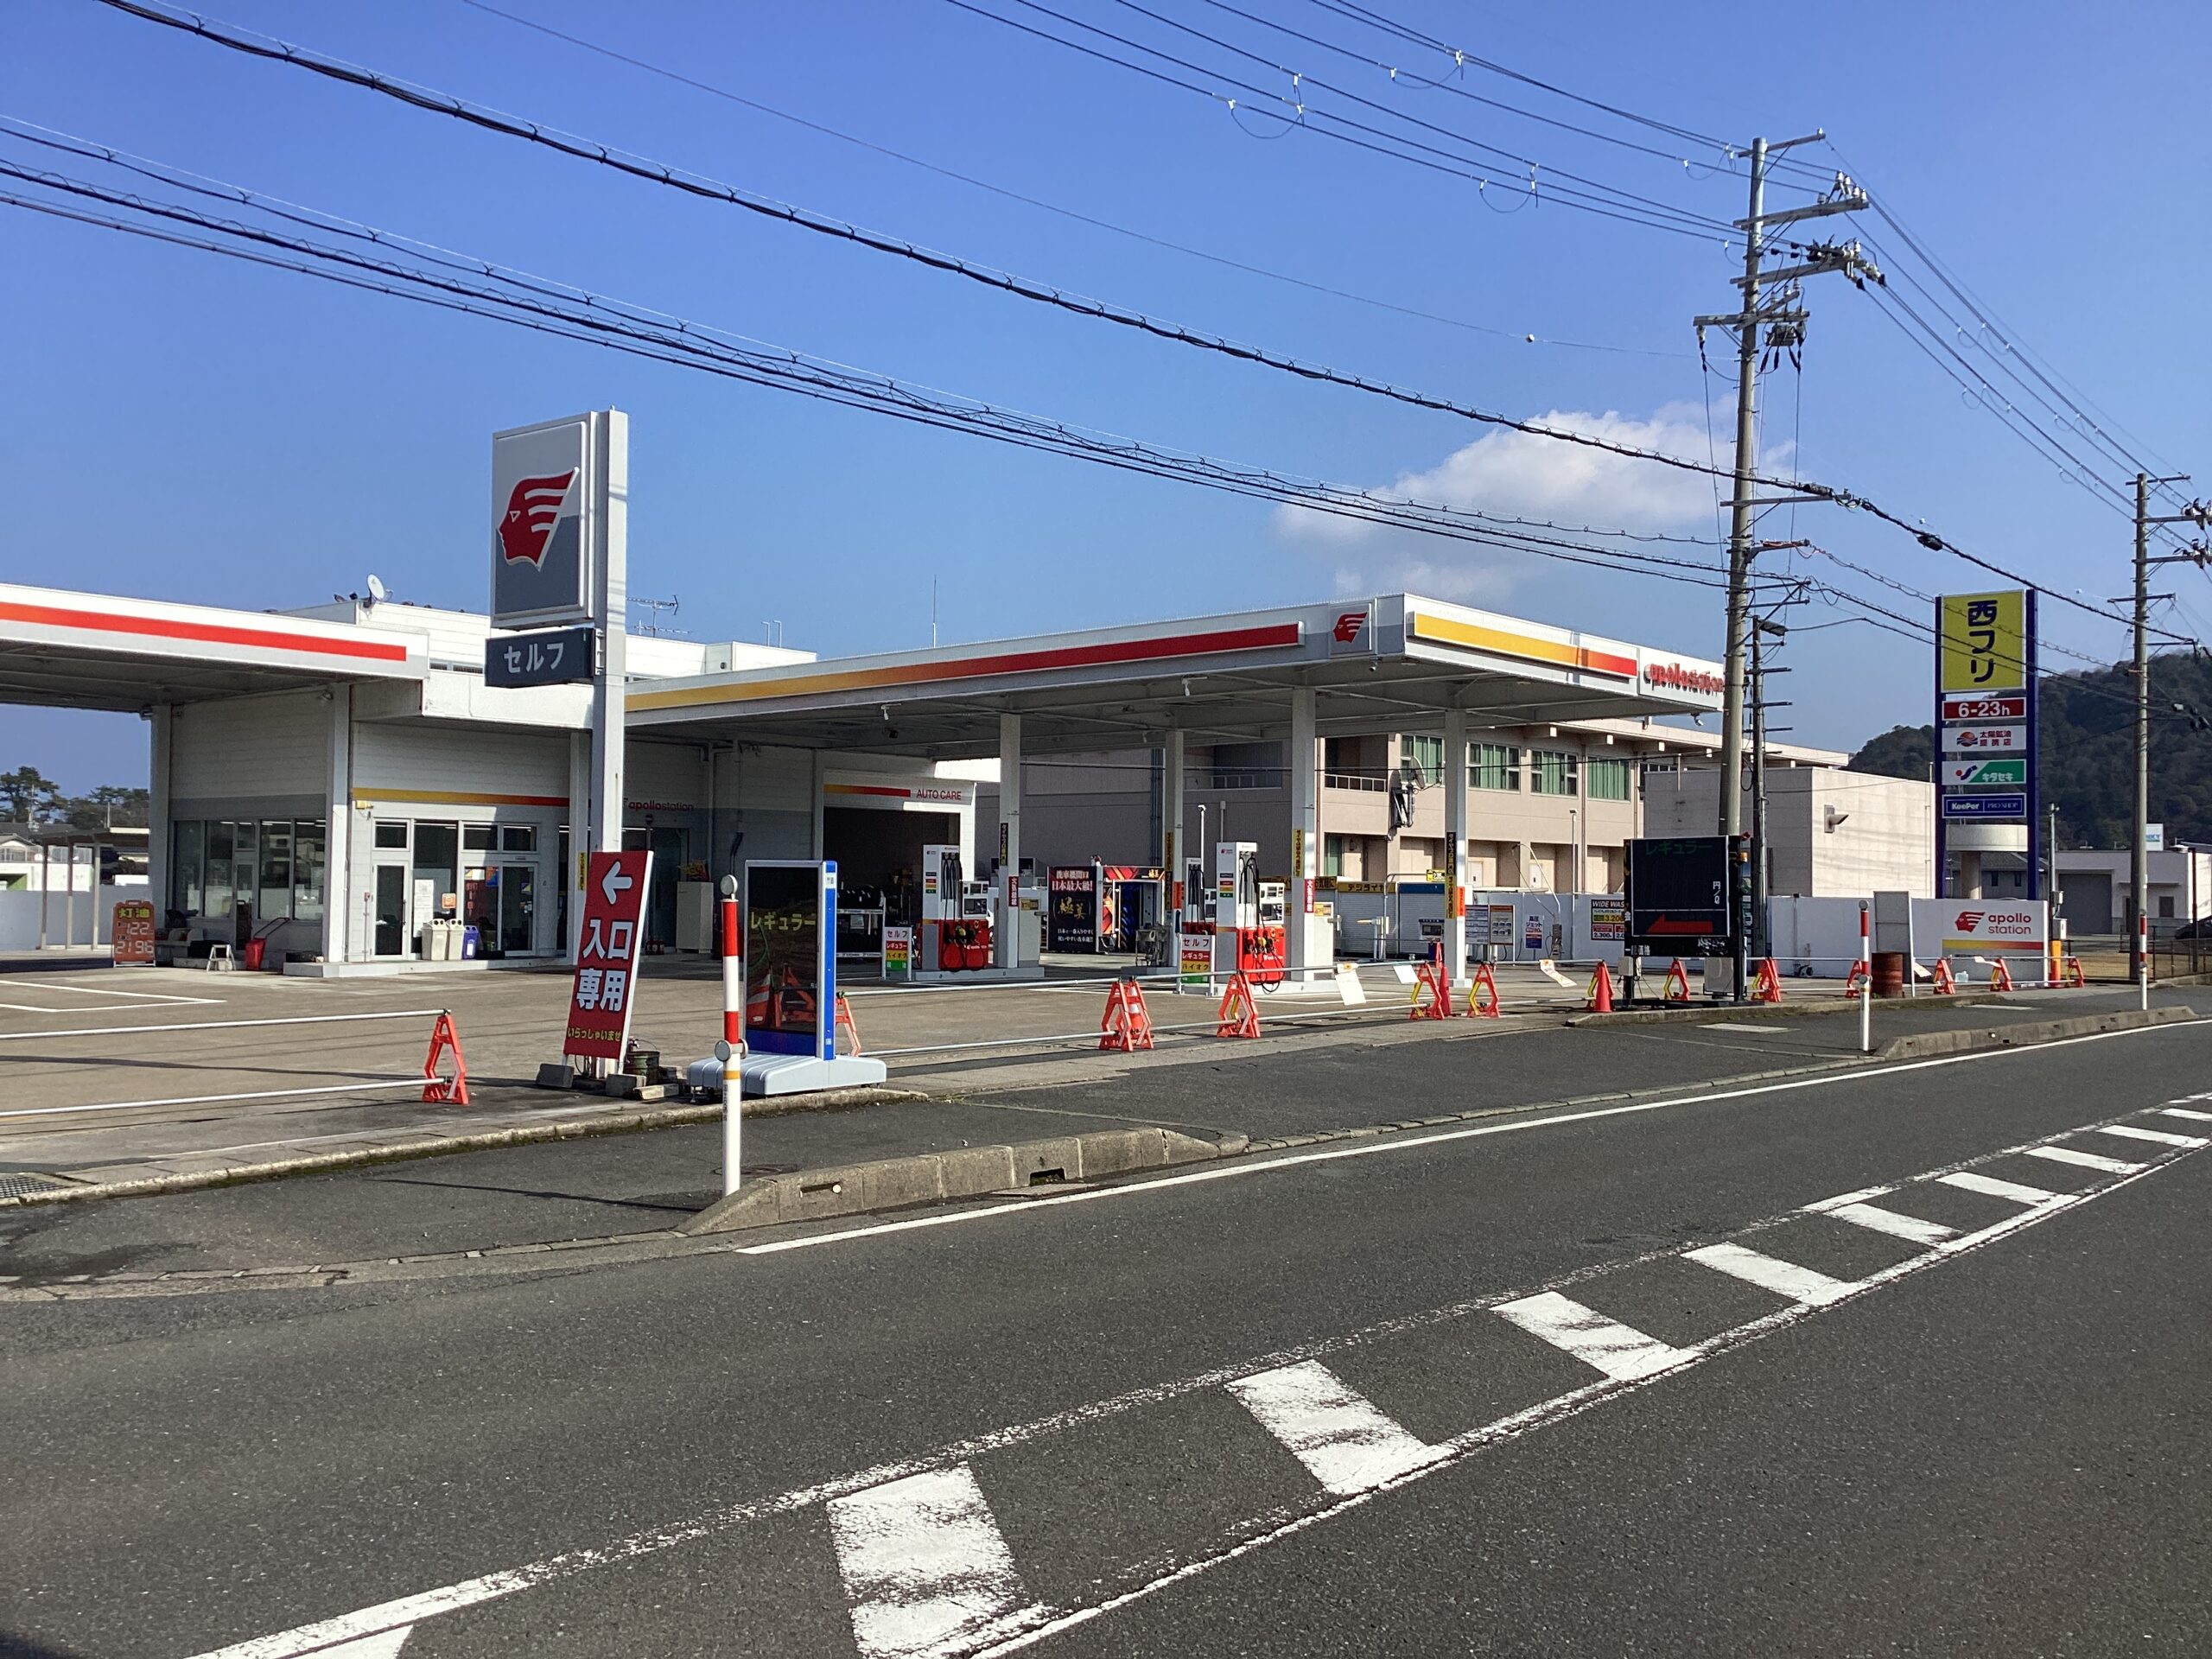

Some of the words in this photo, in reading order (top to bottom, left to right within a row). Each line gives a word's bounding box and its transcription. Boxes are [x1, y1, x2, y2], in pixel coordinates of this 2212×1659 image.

[1967, 600, 1998, 683] 西フリ
[504, 642, 564, 673] セルフ
[1958, 702, 2011, 718] 6-23h
[1981, 772, 2014, 782] キタセキ
[917, 789, 938, 799] AUTO
[940, 791, 962, 800] CARE
[628, 800, 694, 811] apollostation
[1645, 841, 1713, 855] レギュラー
[1052, 880, 1093, 892] 日本最大級!
[118, 908, 150, 918] 灯油
[1988, 912, 2031, 925] apollo
[750, 911, 817, 931] レギュラー
[127, 922, 149, 935] 122
[1988, 925, 2031, 934] station
[582, 918, 633, 960] 入口
[1183, 938, 1209, 947] セルフ
[576, 969, 627, 1012] 専用
[567, 1028, 622, 1042] いらっしゃいませ
